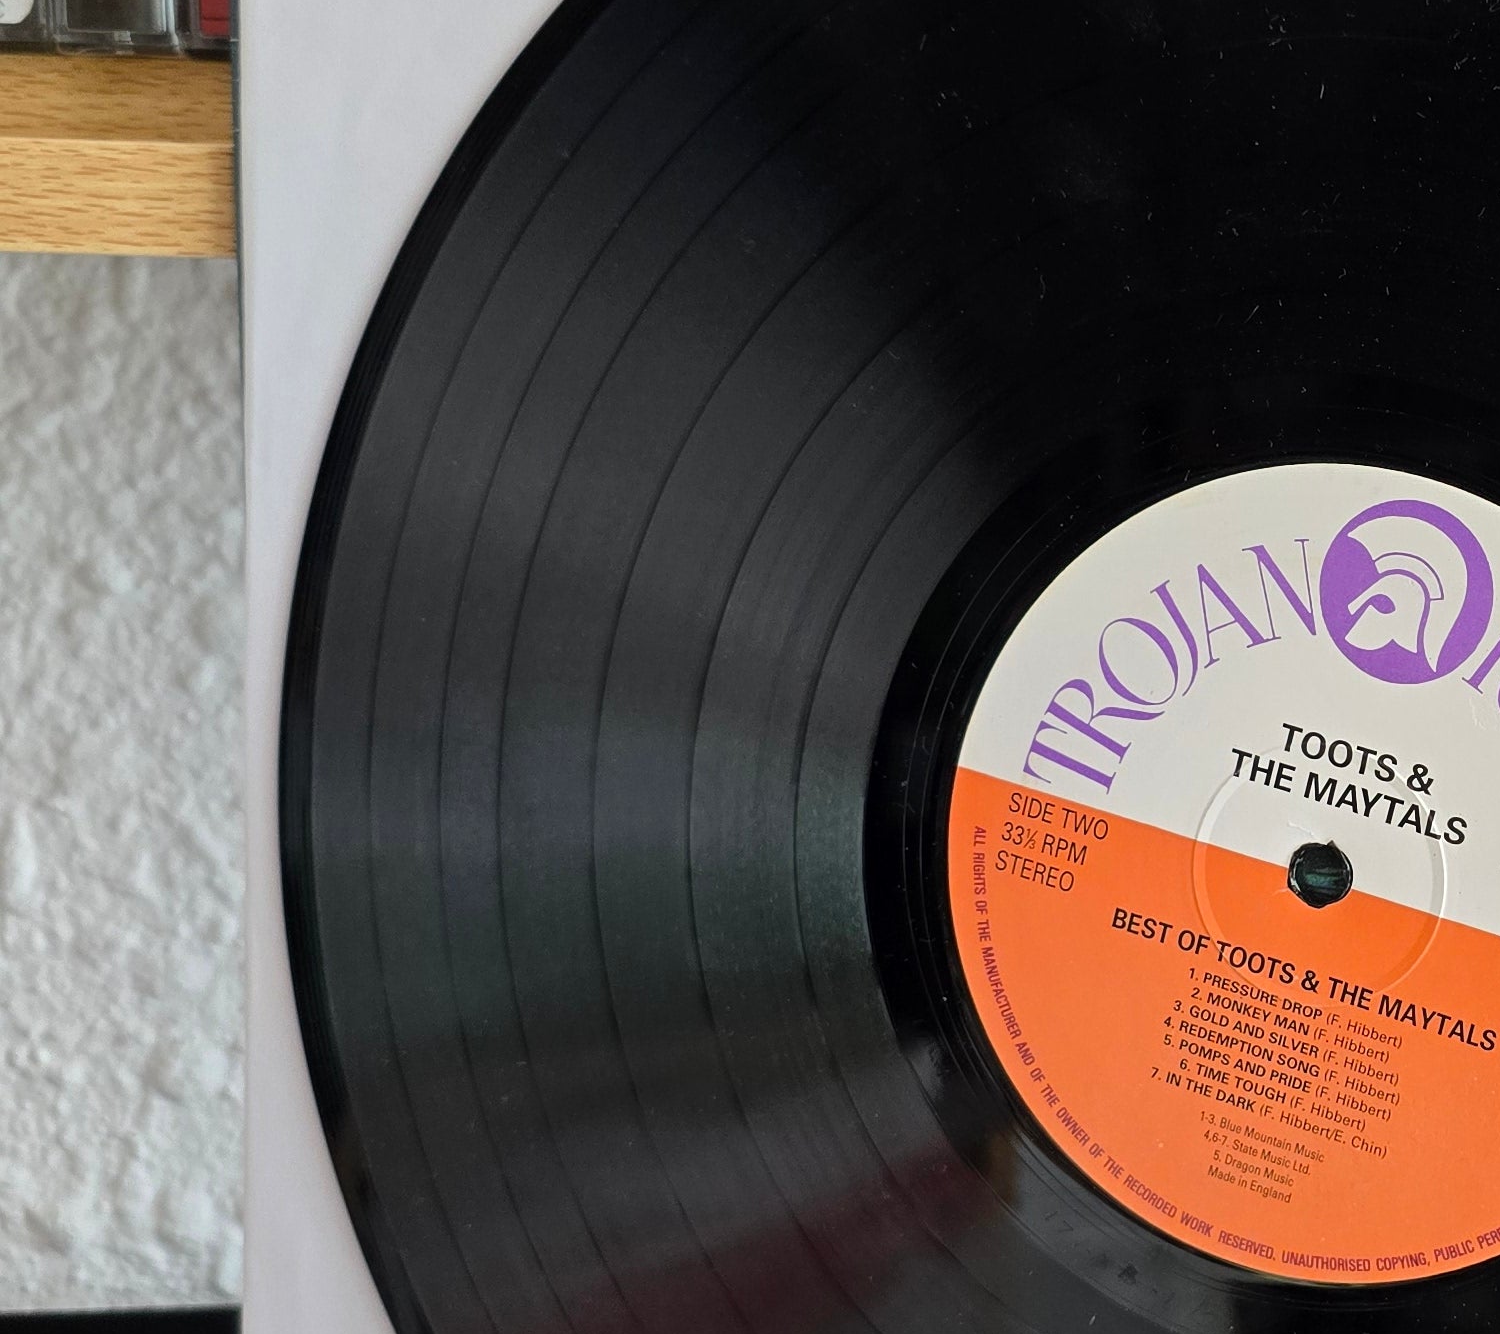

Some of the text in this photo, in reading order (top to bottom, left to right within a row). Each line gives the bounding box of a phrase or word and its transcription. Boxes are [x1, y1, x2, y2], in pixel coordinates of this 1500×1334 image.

[1023, 538, 1317, 795] TROJAN
[1282, 722, 1435, 796] TOOTS &
[1008, 792, 1110, 841] SIDE TWO
[1231, 748, 1468, 846] THE MAYTALS
[973, 825, 987, 847] ALL
[1041, 833, 1088, 866] RPM
[972, 851, 987, 896] RIGHTS
[994, 849, 1076, 893] STEREO
[975, 899, 989, 915] OF
[977, 918, 992, 942] THE
[981, 945, 1023, 1040] MANUFACTURER
[1111, 906, 1498, 1053] BEST OF TOOTS & THE MAYTALS
[1188, 967, 1403, 1049] 1. PRESSURE DROP (F. Hibbert)
[1191, 987, 1390, 1064] 2. MONKEY MAN (F. Hibbert)
[1015, 1041, 1036, 1067] AND
[1163, 1016, 1400, 1107] 4. REDEMPTION SONG (F. Hibbert)
[1173, 999, 1400, 1087] 3. GOLD AND SILVER (F. Hibbert)
[1029, 1067, 1046, 1084] OF
[1040, 1083, 1061, 1108] THE
[1163, 1033, 1392, 1123] 5. POMPS AND PRIDE (F. Hibbert)
[1179, 1058, 1366, 1132] 6. TIME TOUGH (F. Hibbert)
[1055, 1106, 1091, 1147] OWNER
[1151, 1066, 1388, 1159] 7. IN THE DARK (F. Hibbert/E. Chin)
[1088, 1142, 1106, 1159] OF
[1200, 1110, 1325, 1163] 1-3. Blue Mountain Music
[1203, 1129, 1311, 1176] 4,6-7. State Music Ltd.
[1103, 1155, 1125, 1180] THE
[1207, 1165, 1292, 1204] Made in England
[1213, 1149, 1295, 1187] 5. Dragon Music
[1123, 1174, 1178, 1219] RECORDED
[1180, 1210, 1214, 1238] WORK
[1218, 1230, 1276, 1261] RESERVED.
[1281, 1249, 1371, 1272] UNAUTHORISED
[1376, 1251, 1431, 1271] COPYING,
[1433, 1240, 1475, 1263] PUBLIC
